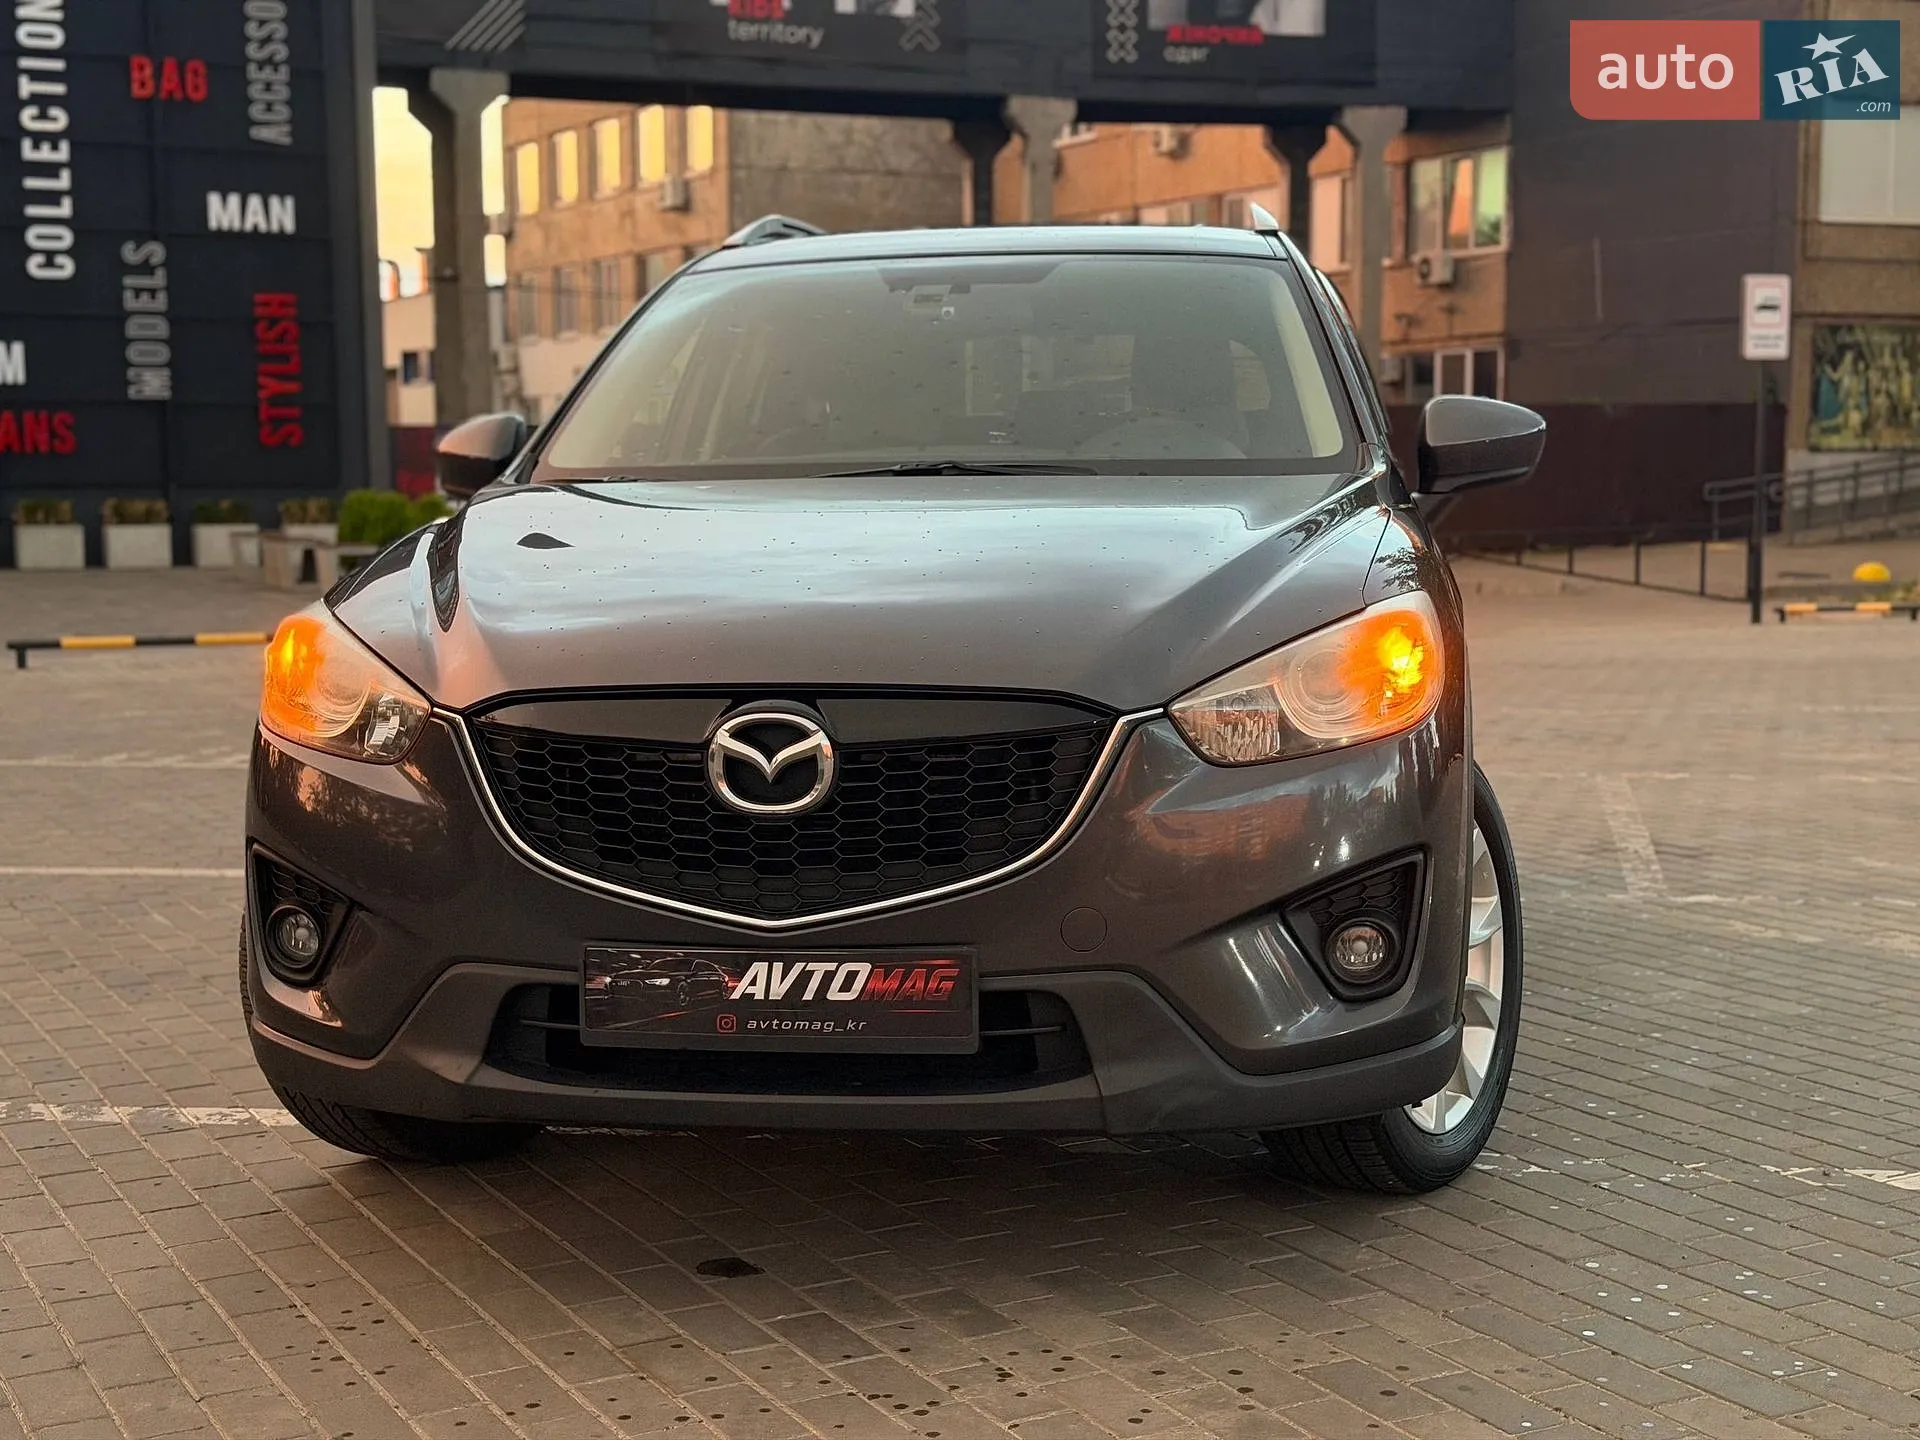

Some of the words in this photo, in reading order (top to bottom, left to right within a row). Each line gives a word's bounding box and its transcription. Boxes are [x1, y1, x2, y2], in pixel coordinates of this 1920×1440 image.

[727, 19, 825, 49] territory
[129, 55, 208, 101] BAG
[15, 0, 76, 281] COLLECTION
[206, 191, 297, 235] MAN
[120, 240, 172, 401] MODELS
[253, 293, 304, 447] STYLISH
[0, 409, 77, 456] ANS
[728, 961, 961, 1003] AVTOMAG
[746, 1018, 867, 1034] avtomag_kr
